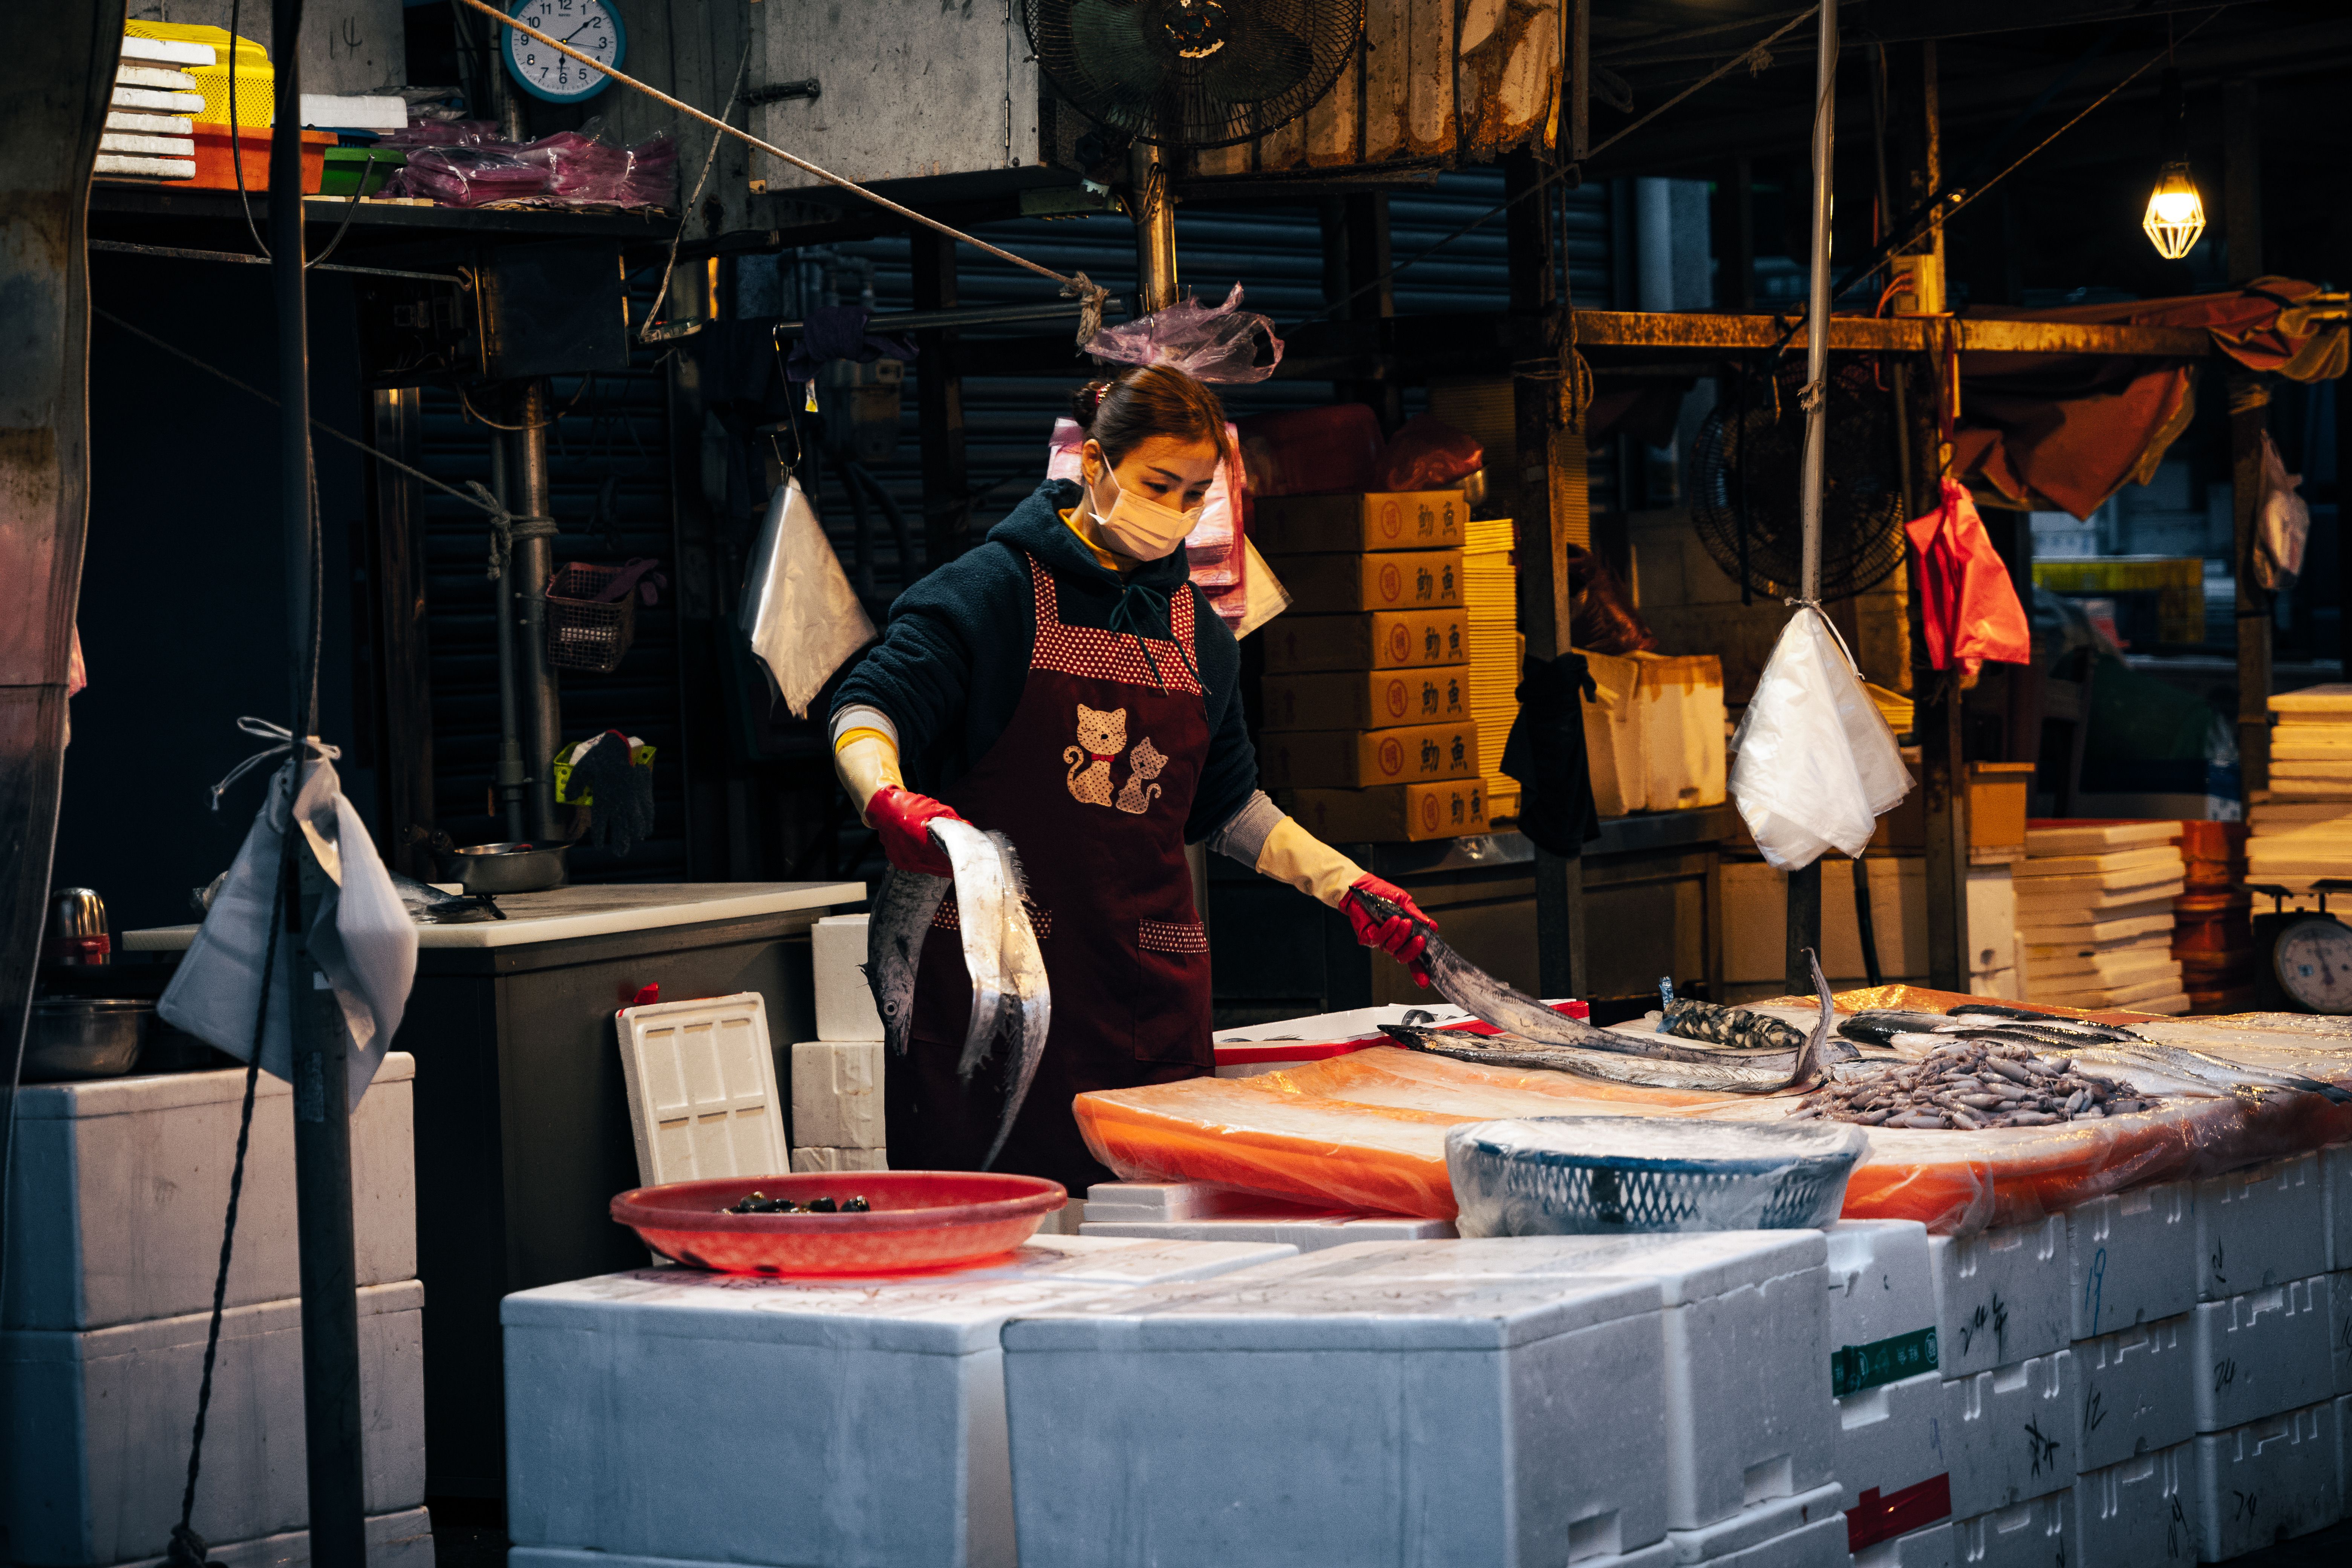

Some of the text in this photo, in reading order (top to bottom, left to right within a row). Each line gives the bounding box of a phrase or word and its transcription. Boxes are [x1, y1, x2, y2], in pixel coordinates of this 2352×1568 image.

[540, 3, 551, 14] 11
[558, 0, 572, 10] 12
[580, 4, 585, 15] 1
[527, 16, 541, 28] 10
[593, 16, 601, 28] 2
[521, 34, 528, 46] 9
[598, 37, 607, 49] 3
[527, 54, 535, 66] 8
[541, 67, 549, 78] 7
[559, 73, 567, 84] 6
[579, 68, 587, 80] 5
[2085, 1248, 2106, 1337] 19
[2084, 1381, 2108, 1434] 12
